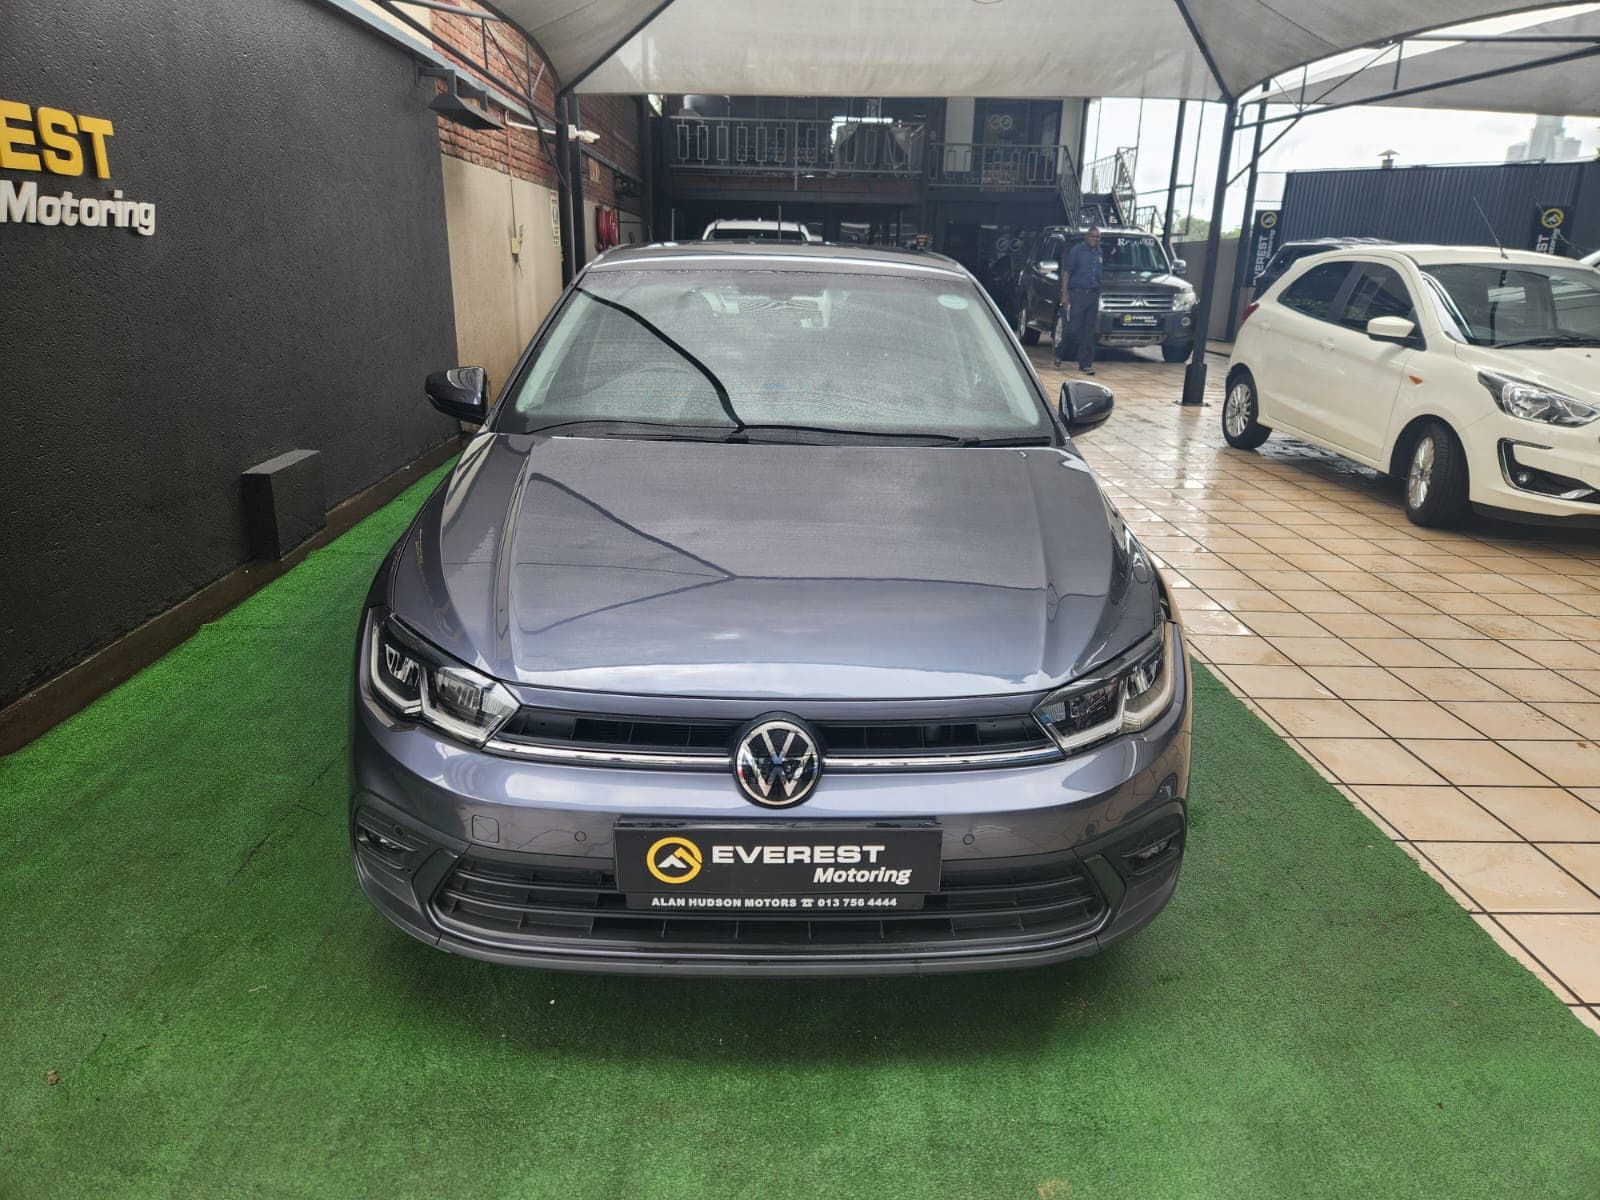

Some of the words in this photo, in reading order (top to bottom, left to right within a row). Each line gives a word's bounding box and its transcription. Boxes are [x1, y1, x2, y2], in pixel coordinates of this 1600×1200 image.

[0, 100, 114, 179] EST
[0, 179, 156, 236] Motoring
[711, 845, 885, 864] EVEREST
[813, 866, 912, 885] Motoring
[651, 897, 685, 907] ALAN
[688, 898, 741, 908] HUDSON
[744, 898, 797, 908] MOTORS
[817, 898, 840, 908] 013
[842, 898, 865, 908] 756
[867, 898, 898, 908] 4444
